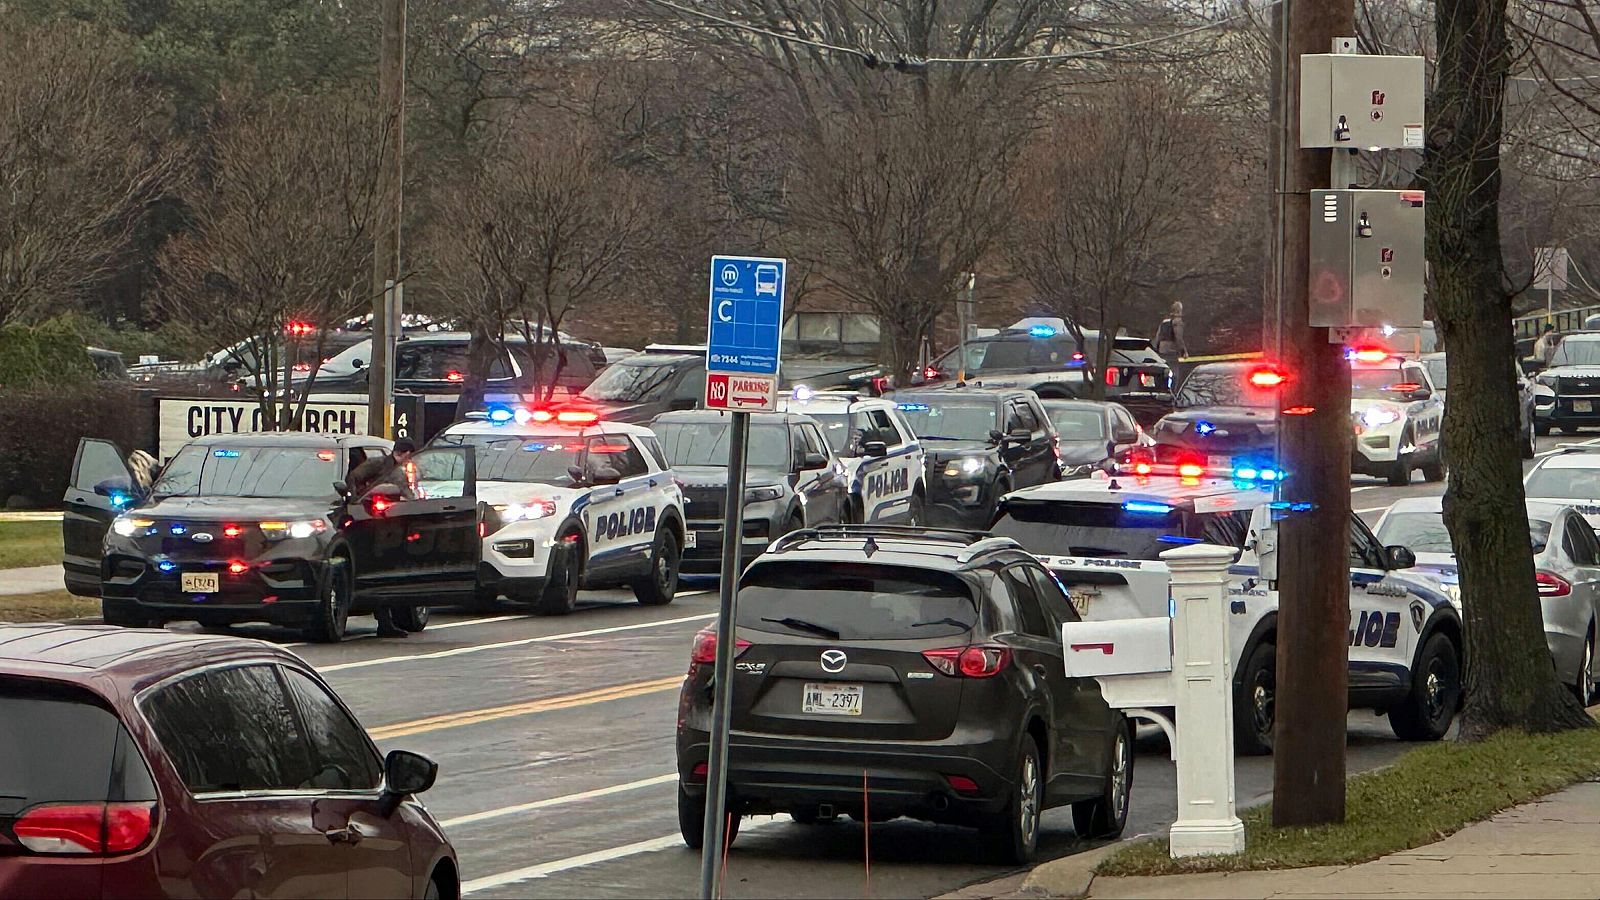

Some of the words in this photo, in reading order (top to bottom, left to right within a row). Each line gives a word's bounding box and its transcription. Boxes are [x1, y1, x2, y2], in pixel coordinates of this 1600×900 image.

[717, 299, 733, 322] C
[710, 381, 726, 400] NO
[732, 380, 770, 394] PARKING
[187, 405, 244, 437] CITY
[595, 506, 656, 542] POLICE
[1083, 558, 1142, 569] POLICE
